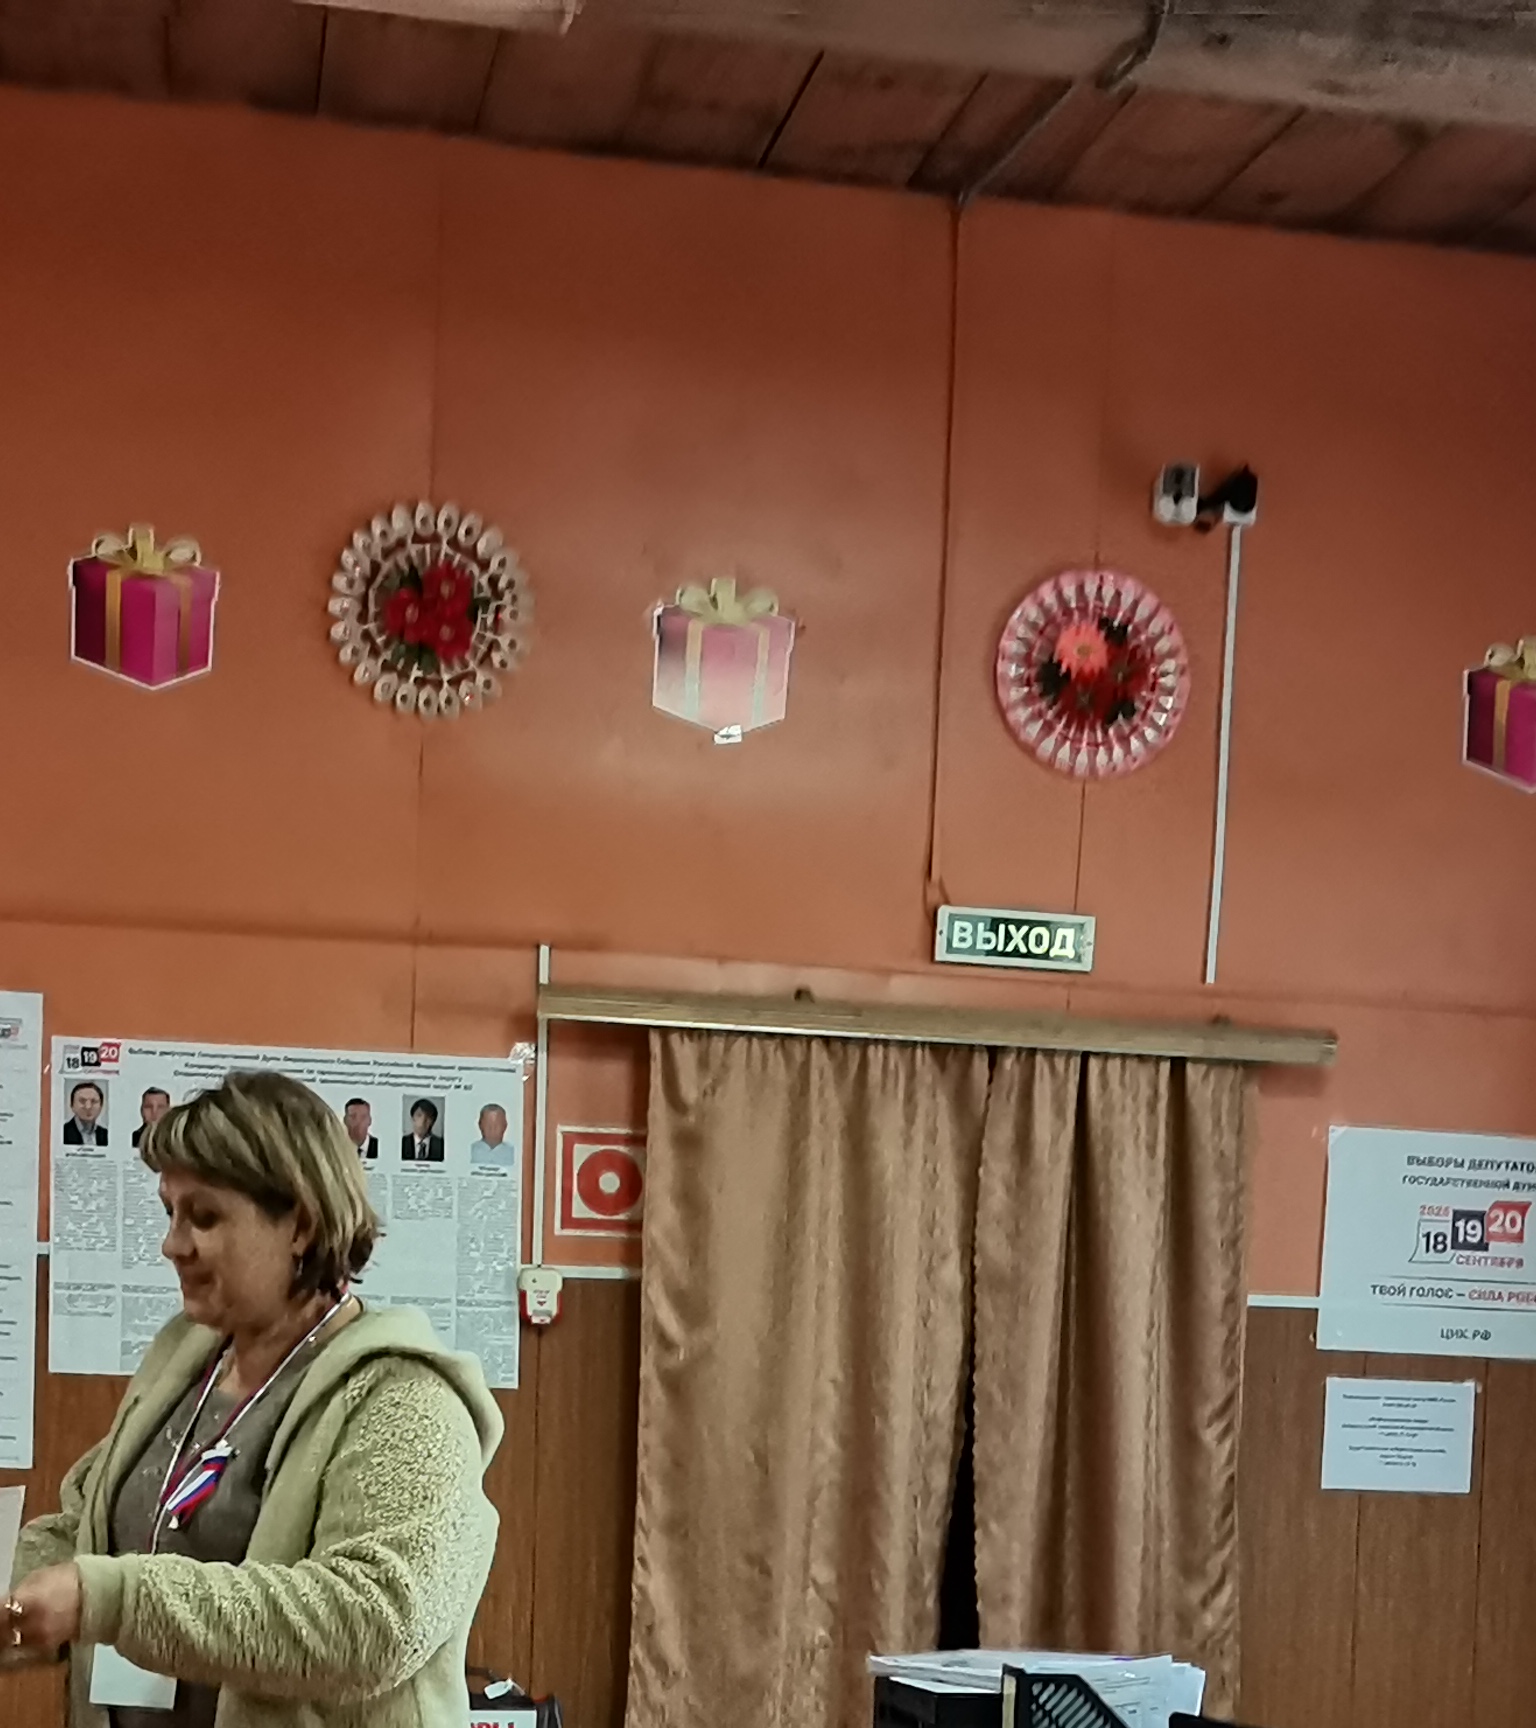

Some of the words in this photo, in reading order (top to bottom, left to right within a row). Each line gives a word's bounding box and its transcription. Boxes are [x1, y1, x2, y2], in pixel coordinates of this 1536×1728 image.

[952, 921, 1075, 959] ВЫХОД
[66, 1057, 79, 1069] 18
[83, 1051, 97, 1064] 19
[100, 1046, 117, 1058] 20
[1407, 1155, 1464, 1169] ВЫБОРЫ
[1402, 1174, 1510, 1190] ГОСУДАРСТВЕННОЙ
[1422, 1231, 1448, 1254] 18
[1455, 1219, 1483, 1243] 19
[1488, 1209, 1522, 1234] 20
[1455, 1254, 1524, 1269] СЕНТЯБРЯ
[1371, 1283, 1406, 1297] ТВОЙ
[1409, 1286, 1453, 1299] ГОЛОС
[1468, 1291, 1504, 1302] СИЛА
